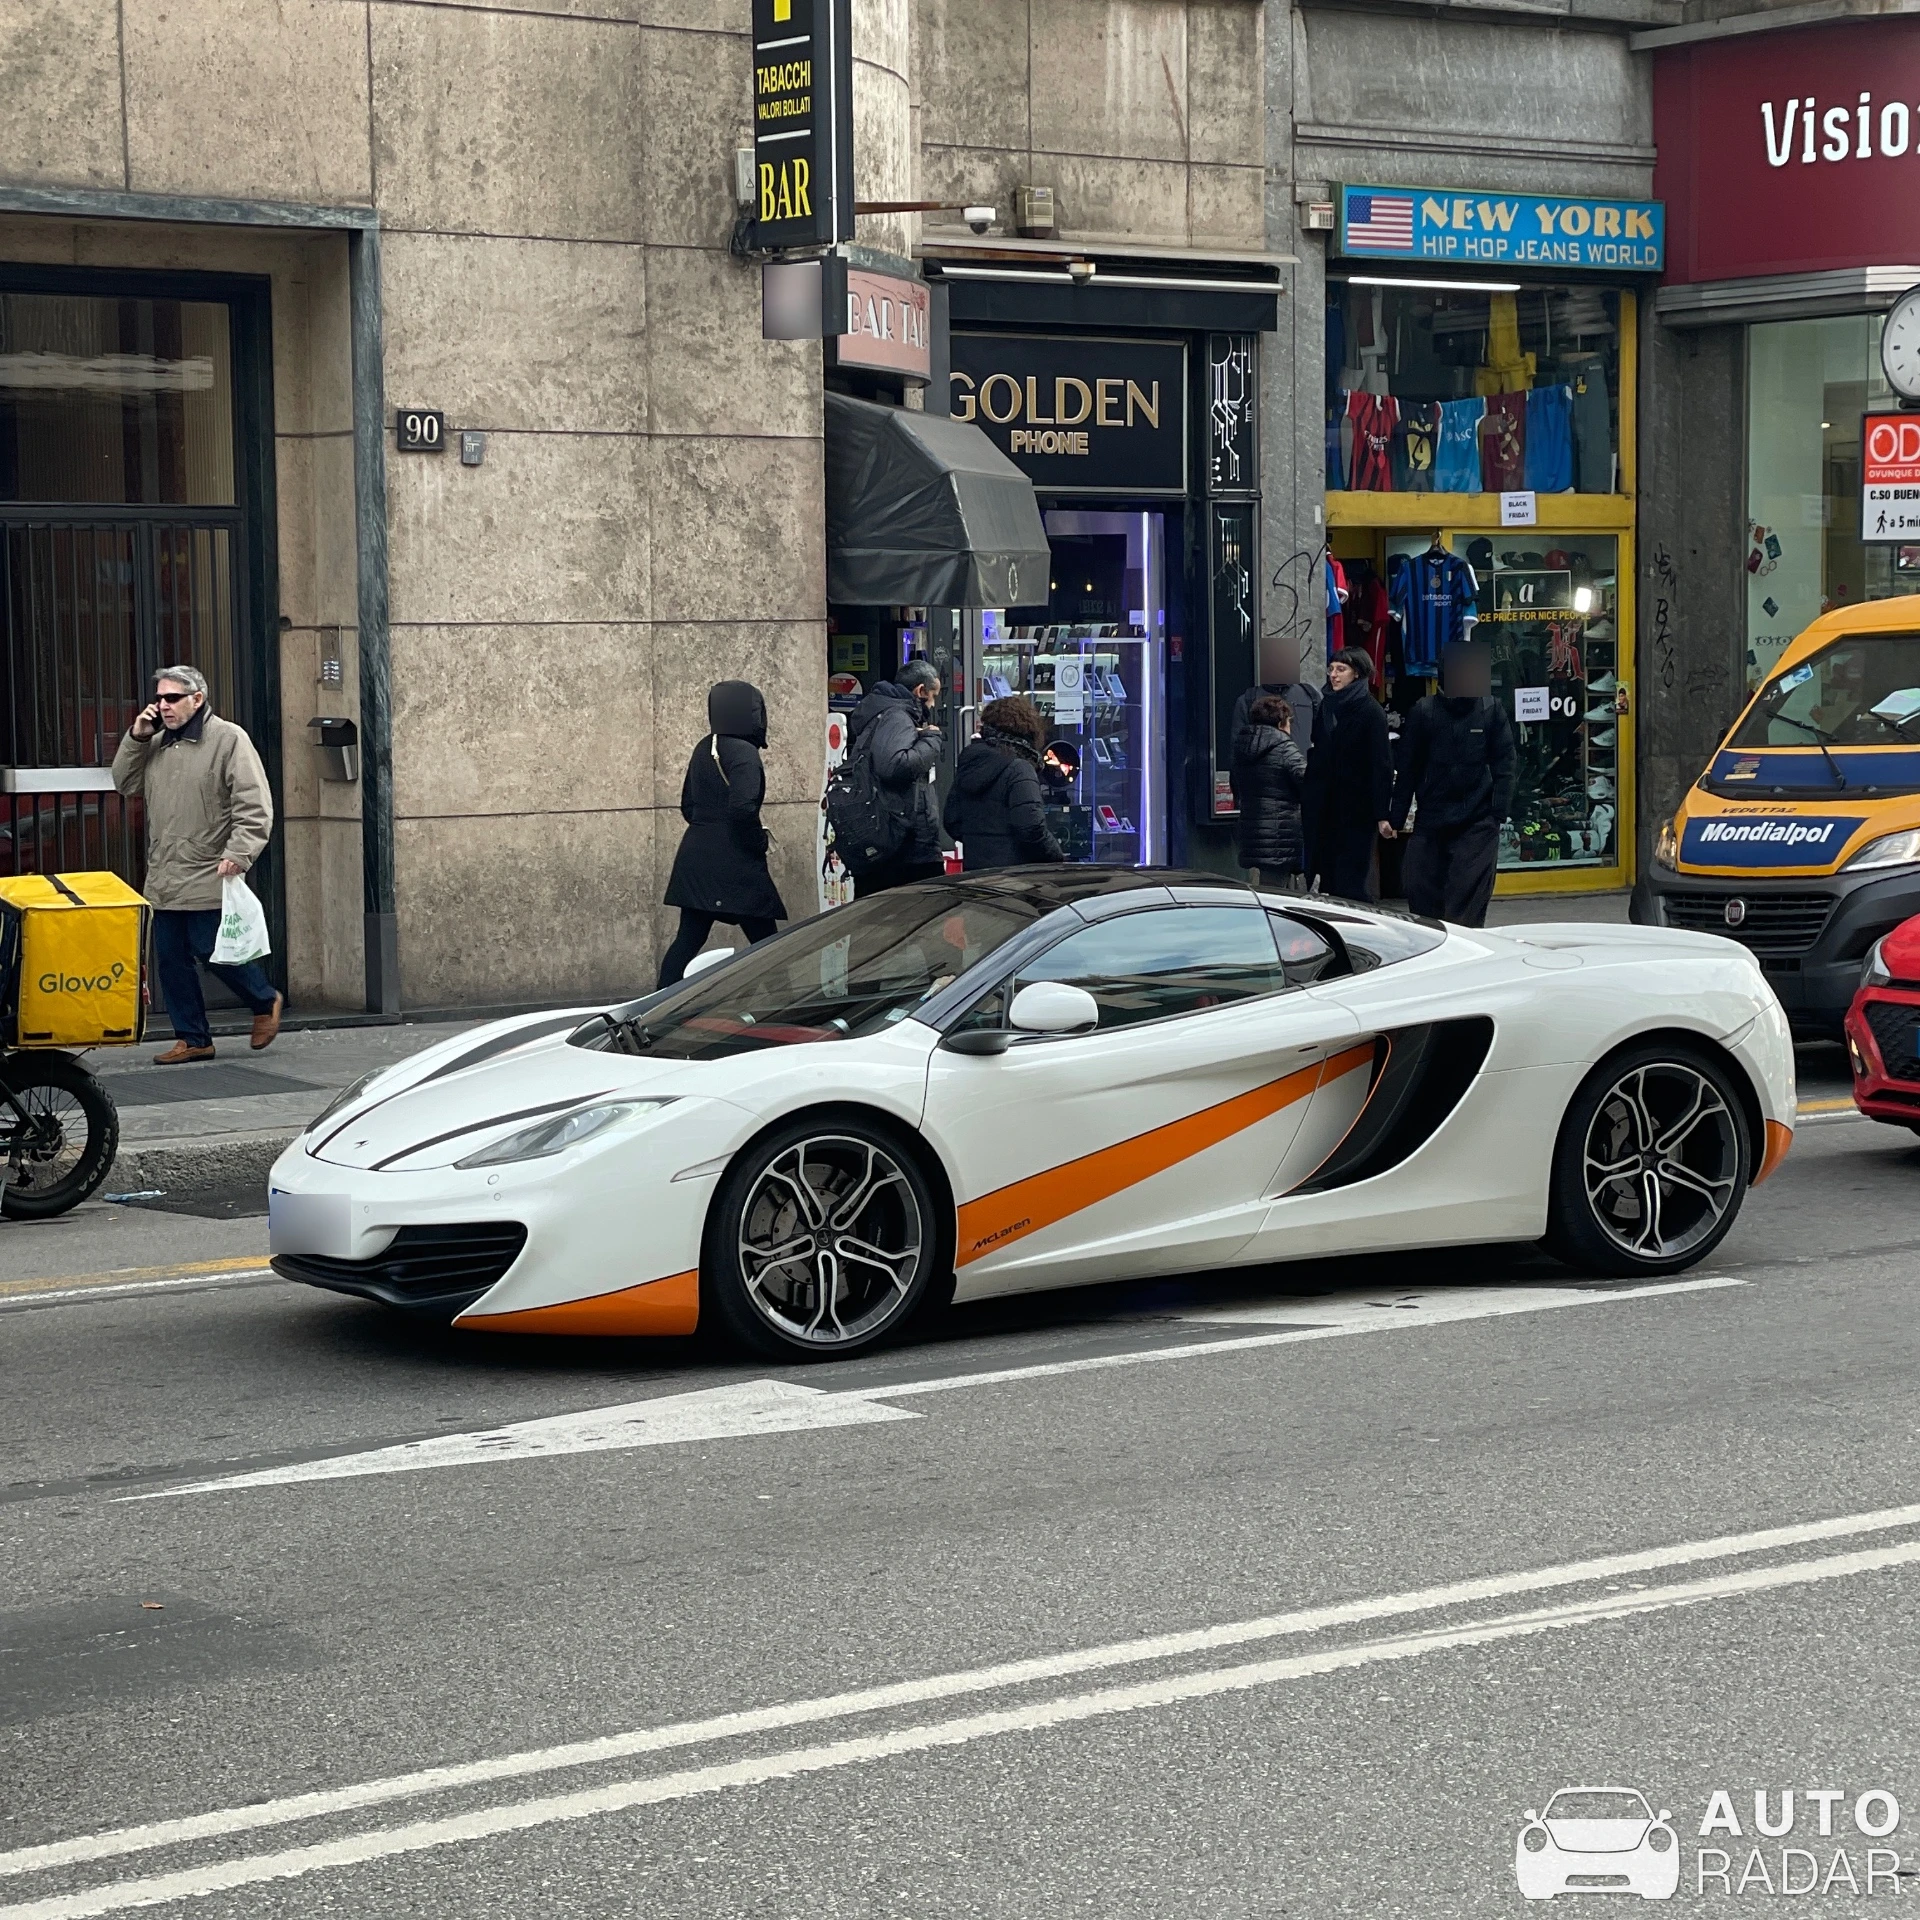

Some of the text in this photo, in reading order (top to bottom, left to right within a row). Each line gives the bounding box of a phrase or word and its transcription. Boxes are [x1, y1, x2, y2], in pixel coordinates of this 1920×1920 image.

[757, 60, 811, 94] TABACCHI
[758, 96, 811, 120] VALORI BOLLATI
[1761, 91, 1920, 167] Visio
[759, 158, 812, 222] BAR
[1421, 196, 1655, 240] NEW YORK
[1422, 235, 1657, 266] HIP HOP JEANS WORLD
[847, 291, 896, 343] BAR
[950, 371, 1159, 429] GOLDEN
[406, 414, 439, 443] 90
[1010, 429, 1089, 456] PHONE
[1868, 469, 1913, 478] OVUNQUE
[1870, 489, 1920, 500] C.SO BUEN
[1890, 518, 1896, 528] a
[1898, 515, 1905, 528] 5
[1477, 613, 1492, 623] ICE
[1493, 612, 1518, 622] PRICE
[1519, 611, 1537, 621] FOR
[1538, 610, 1558, 620] NICE
[1522, 696, 1541, 704] BLACK
[1522, 707, 1543, 715] FRIDAY
[1700, 822, 1835, 845] Mondialpol
[39, 973, 112, 993] Glovo
[972, 1218, 1031, 1251] McLaren
